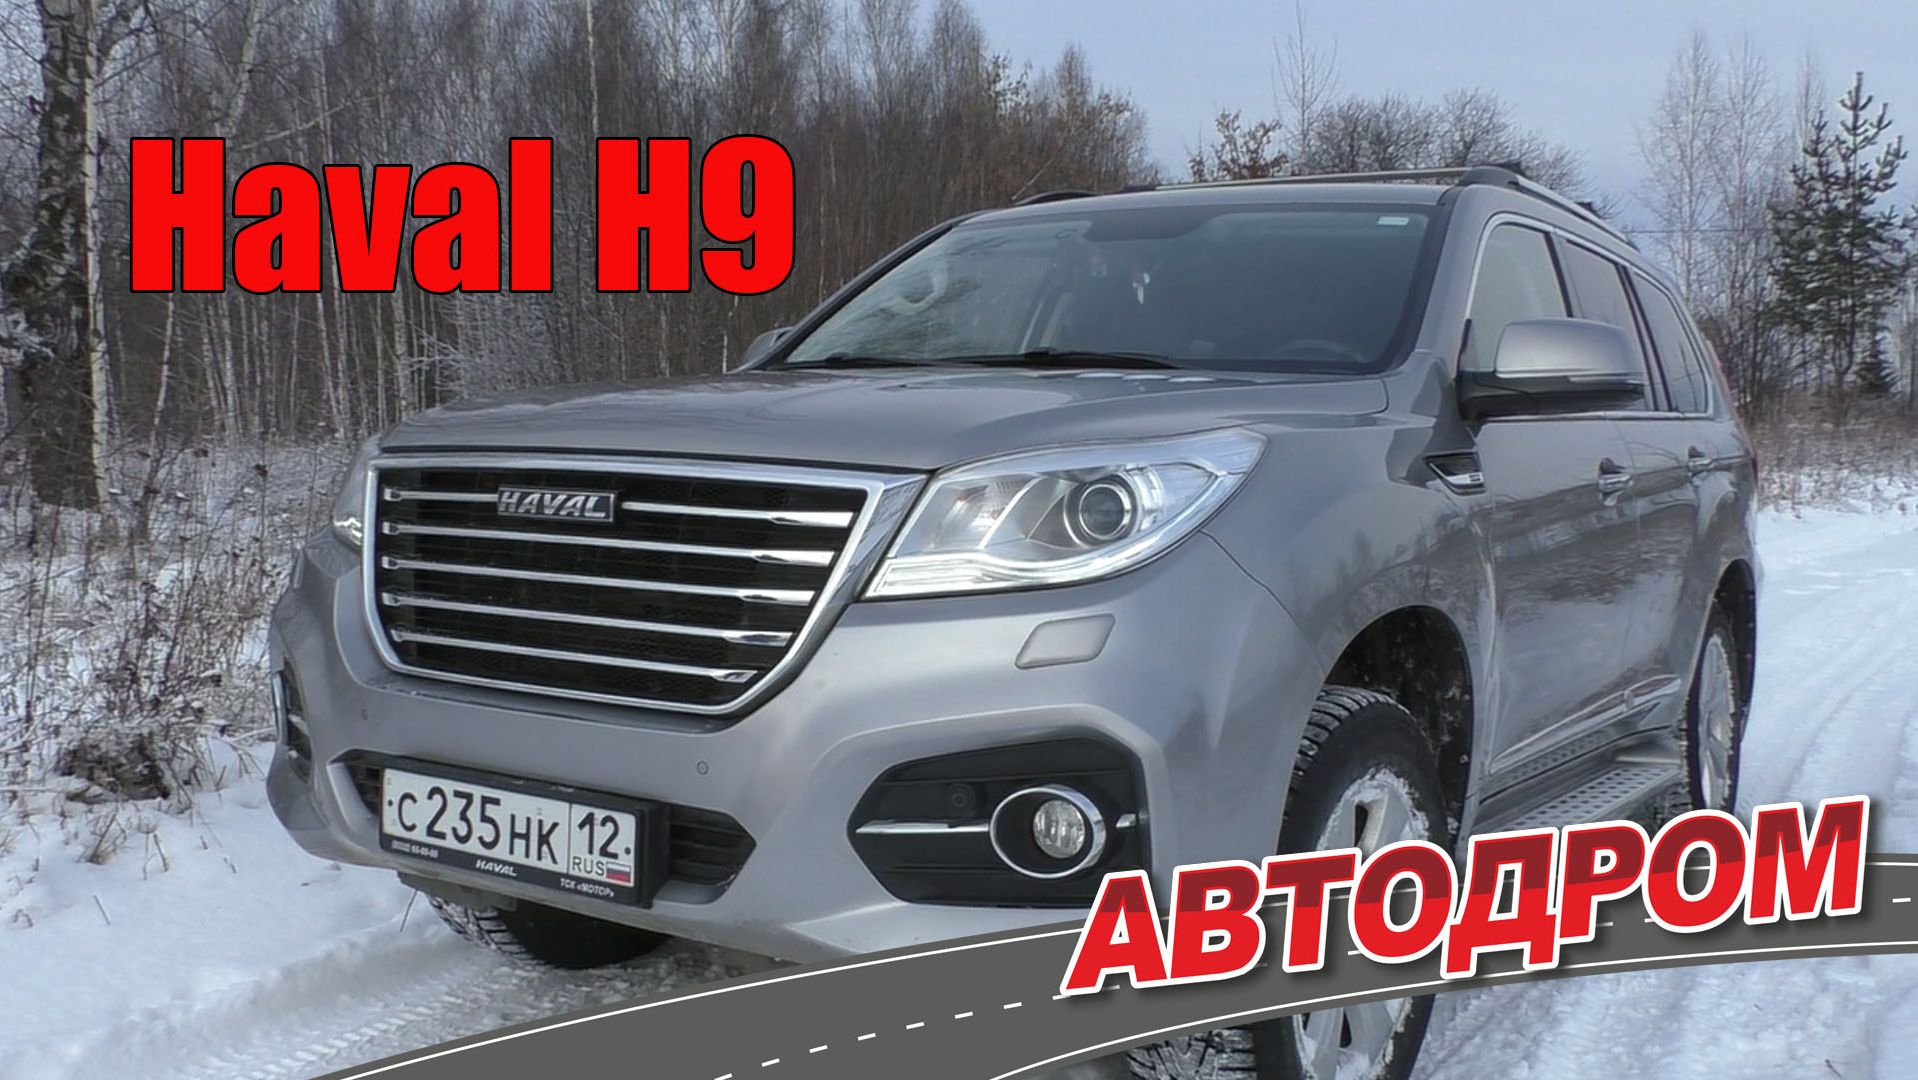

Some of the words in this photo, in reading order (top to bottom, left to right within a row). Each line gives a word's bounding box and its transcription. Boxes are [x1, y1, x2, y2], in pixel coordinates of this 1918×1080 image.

[500, 491, 607, 518] HAVAL
[577, 811, 619, 860] 12
[475, 858, 518, 877] HAVAL
[571, 854, 606, 877] RUS
